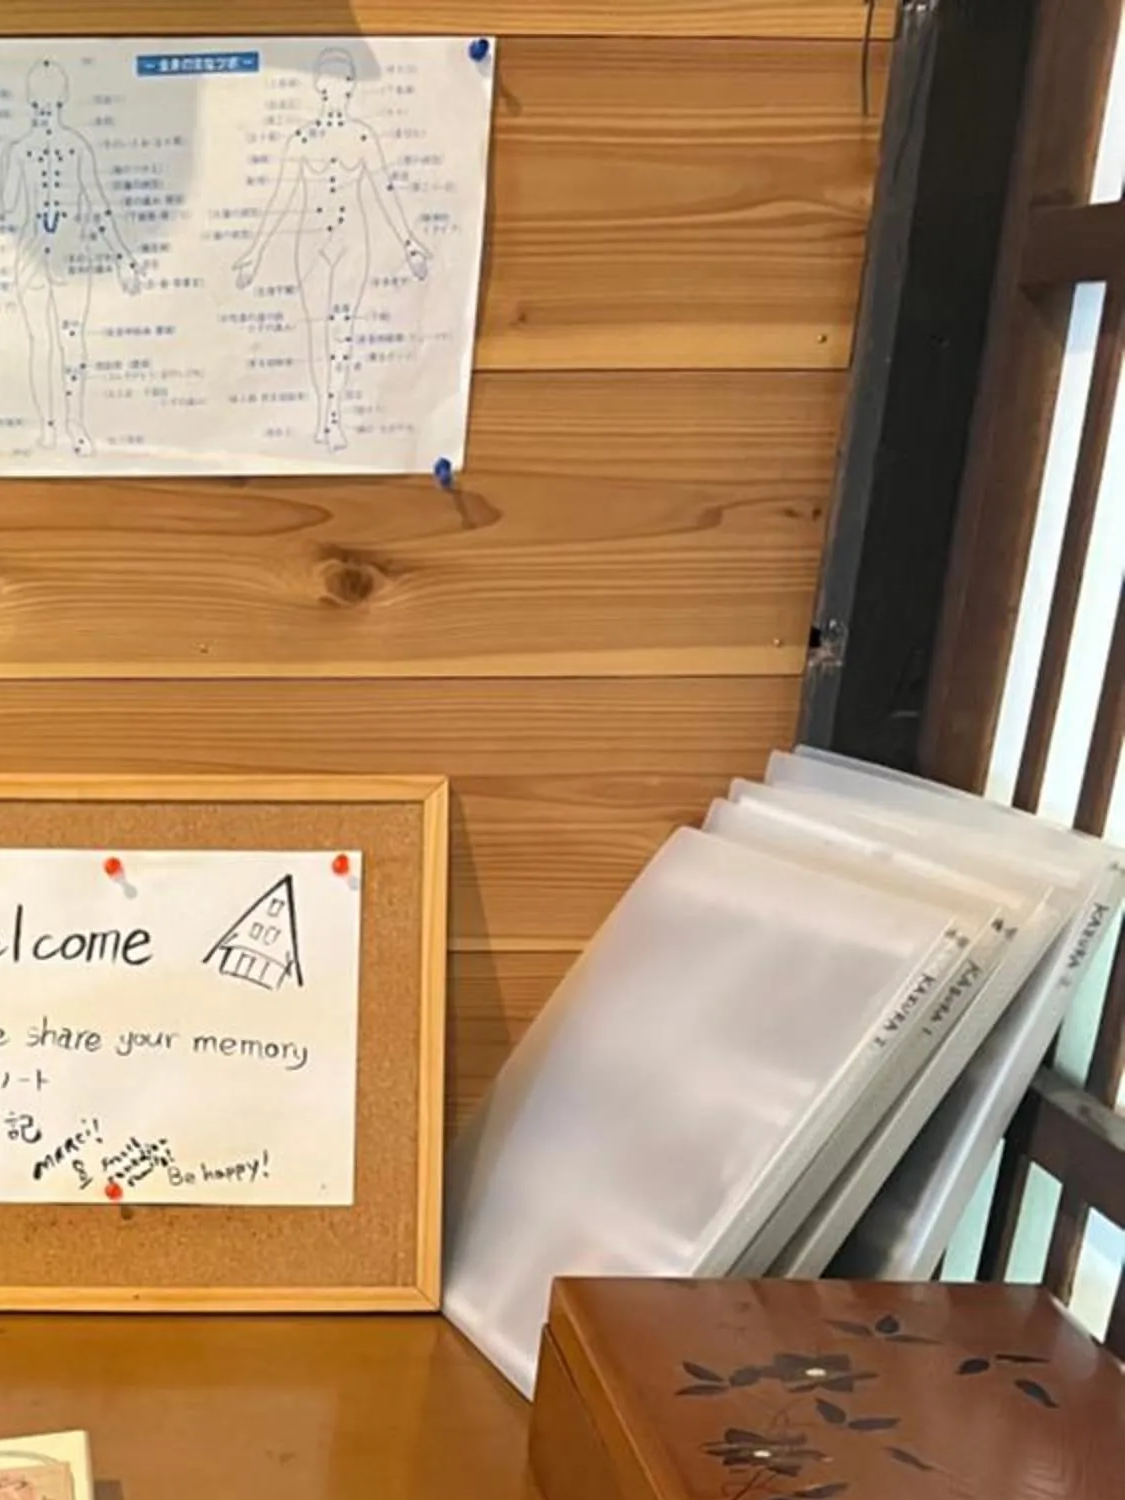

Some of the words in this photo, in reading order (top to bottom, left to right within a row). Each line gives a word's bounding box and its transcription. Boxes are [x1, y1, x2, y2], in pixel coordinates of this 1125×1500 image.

[26, 1015, 103, 1052] share
[114, 1031, 180, 1057] your
[192, 1035, 309, 1071] memory
[166, 1166, 196, 1187] Be
